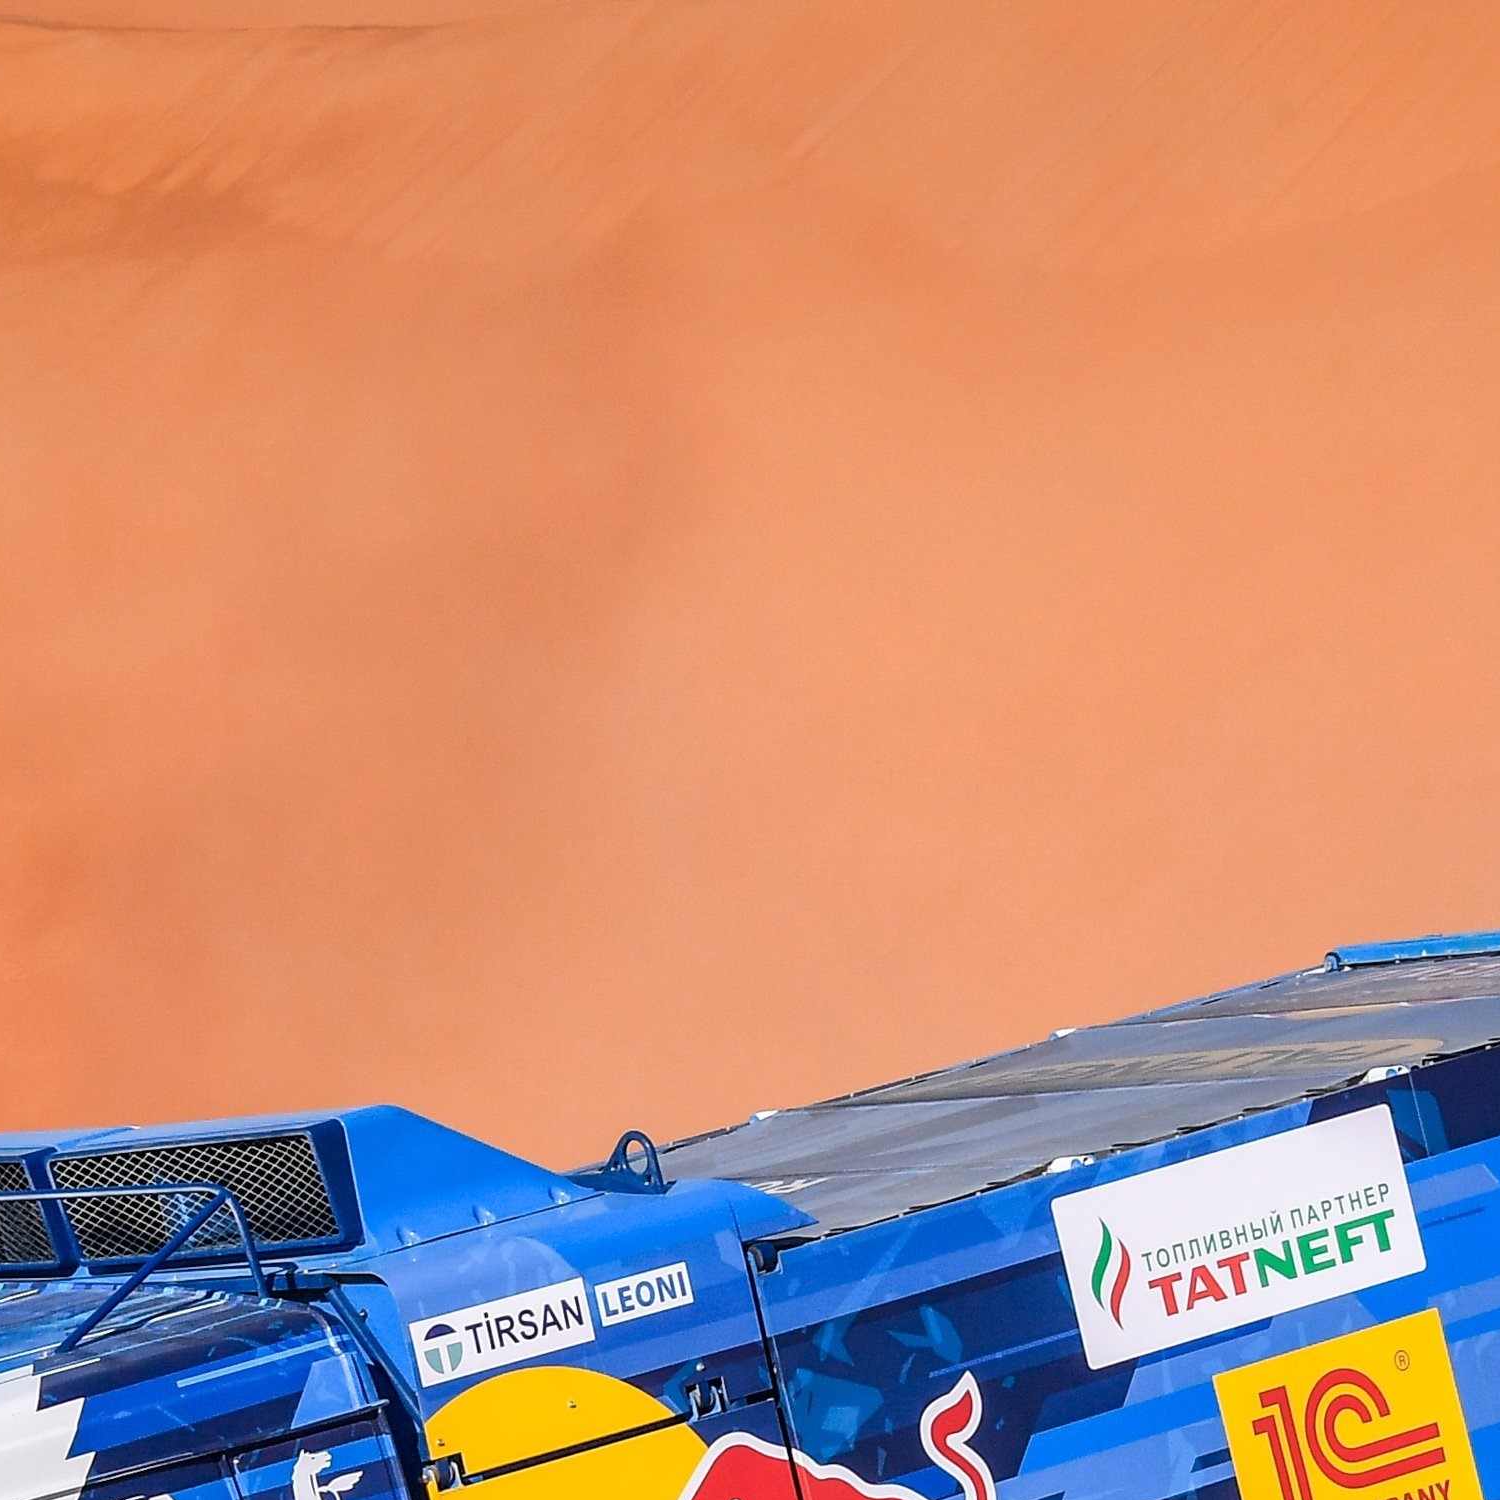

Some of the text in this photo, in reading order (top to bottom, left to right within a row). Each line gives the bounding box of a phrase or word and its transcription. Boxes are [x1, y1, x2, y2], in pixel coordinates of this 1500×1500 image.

[1141, 1183, 1391, 1272] ТОПЛИВНЫЙ ПАРТНЕР
[1148, 1208, 1395, 1317] TATNEFT
[601, 1271, 688, 1317] LEONI
